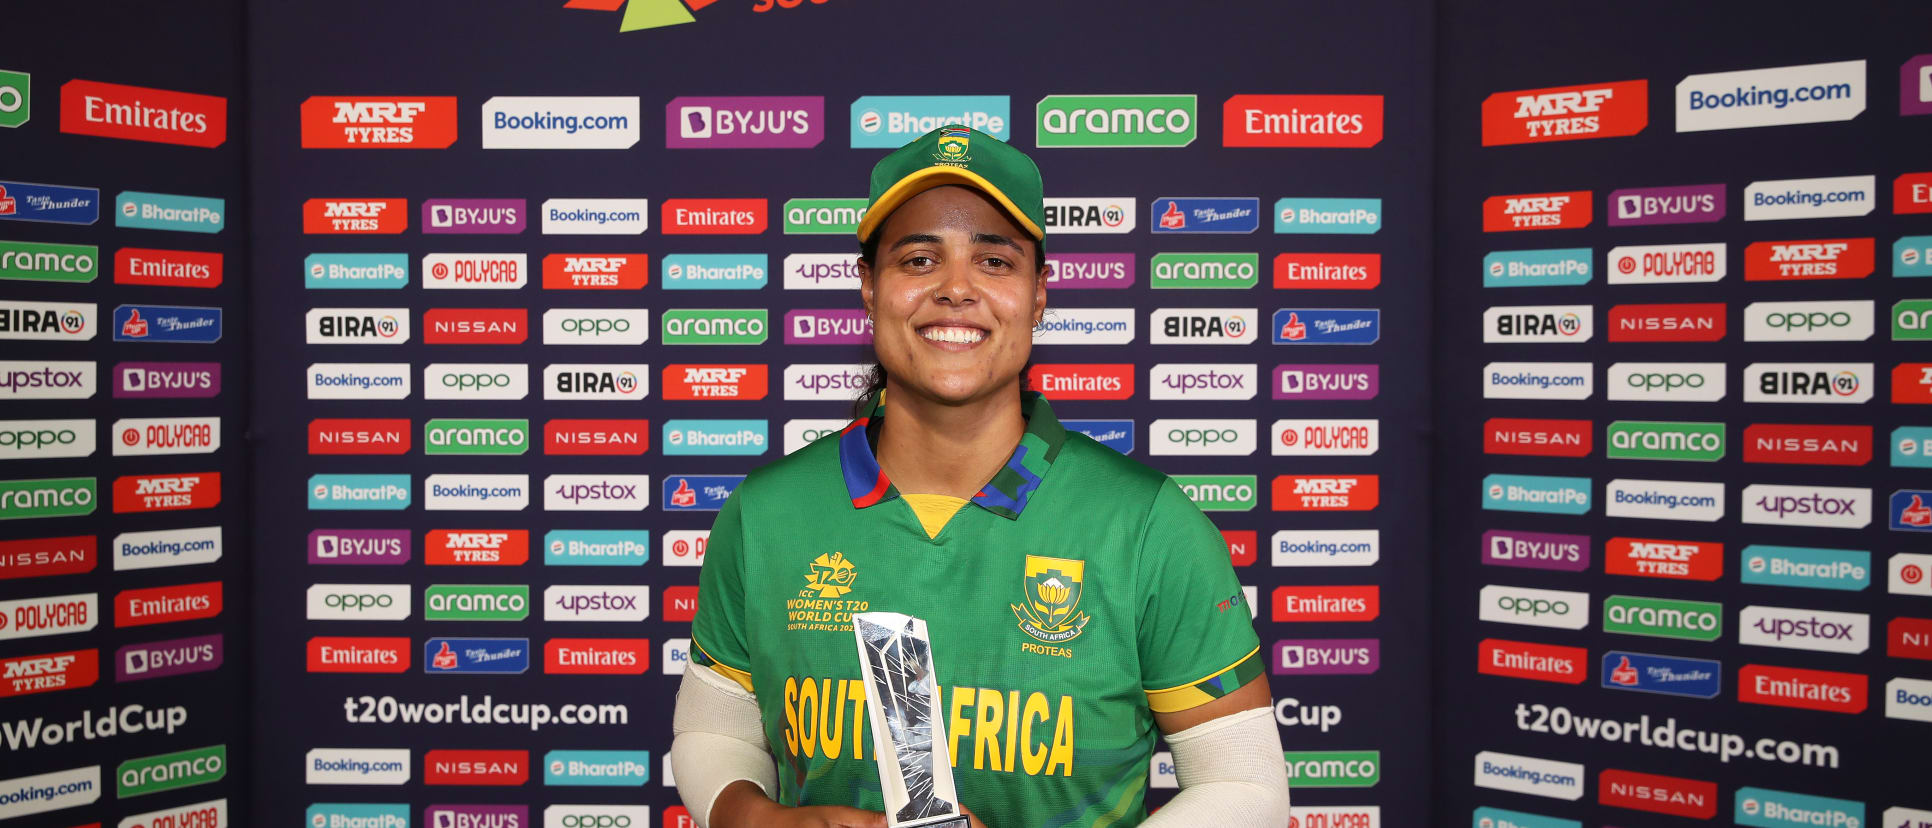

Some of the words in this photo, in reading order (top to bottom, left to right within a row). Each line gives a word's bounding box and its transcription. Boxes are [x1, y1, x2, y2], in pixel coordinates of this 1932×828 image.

[1513, 89, 1612, 118] MRF
[1690, 84, 1850, 110] Booking.com
[84, 96, 206, 133] Emirates
[332, 102, 425, 123] MRF
[1043, 108, 1190, 134] aramco
[494, 112, 627, 134] Booking.com
[716, 110, 809, 134] BYJU'S
[1244, 109, 1362, 134] Emirates
[1526, 116, 1599, 137] TYRES
[344, 127, 413, 143] TYRES
[41, 198, 91, 211] Thunder
[1503, 196, 1570, 214] MRF
[1643, 195, 1714, 215] BYJU'S
[1754, 191, 1864, 206] Booking.com
[141, 204, 220, 224] BharatPe
[323, 202, 386, 217] MRF
[454, 208, 516, 224] BYJU'S
[550, 209, 639, 224] Booking.com
[676, 208, 754, 225] Emirates
[1107, 211, 1119, 221] 91
[1298, 209, 1377, 224] BharatPe
[331, 219, 378, 230] TYRES
[1512, 214, 1560, 227] TYRES
[1769, 243, 1847, 261] MRF
[2, 251, 93, 273] ramco
[129, 258, 209, 278] Emirates
[563, 258, 626, 272] MRF
[1062, 262, 1125, 279] BYJU'S
[1155, 262, 1253, 279] aramco
[1507, 260, 1588, 277] BharatPe
[1643, 251, 1714, 276] POLYCAB
[1779, 263, 1837, 276] TYRES
[328, 264, 404, 279] BharatPe
[454, 261, 517, 282] POLYCAB
[571, 275, 618, 285] TYRES
[686, 265, 763, 280] BharatPe
[1287, 263, 1367, 280] Emirates
[65, 316, 79, 328] 91
[382, 321, 394, 332] 91
[435, 322, 516, 332] NISSAN
[560, 319, 630, 336] oppo
[666, 318, 763, 335] aramco
[1229, 321, 1241, 332] 91
[1563, 318, 1575, 330] 91
[1620, 318, 1712, 329] NISSAN
[1765, 312, 1851, 331] oppo
[148, 372, 210, 388] BYJU'S
[315, 374, 402, 389] Booking.com
[441, 374, 510, 391] oppo
[620, 377, 632, 388] 91
[683, 368, 746, 383] MRF
[1042, 373, 1121, 391] Emirates
[1161, 370, 1243, 394] upstox
[1305, 374, 1368, 390] BYJU'S
[1491, 373, 1584, 388] Booking.com
[1627, 373, 1704, 392] oppo
[1838, 378, 1853, 390] 91
[691, 385, 738, 396] TYRES
[0, 430, 75, 450] oppo
[146, 425, 210, 448] POLYCAB
[319, 432, 399, 443] NISSAN
[429, 429, 524, 445] aramco
[555, 432, 637, 443] NISSAN
[686, 430, 764, 445] BharatPe
[1167, 430, 1238, 446] oppo
[1304, 427, 1368, 448] POLYCAB
[1495, 432, 1580, 445] NISSAN
[1611, 431, 1720, 451] aramco
[1756, 438, 1857, 452] NISSAN
[135, 477, 200, 494] MRF
[331, 485, 407, 500] BharatPe
[432, 485, 520, 500] Booking.com
[555, 481, 635, 504] upstox
[1292, 479, 1357, 494] MRF
[1, 488, 92, 509] ramco
[143, 495, 191, 507] TYRES
[1300, 496, 1348, 507] TYRES
[1506, 486, 1587, 504] BharatPe
[1615, 490, 1715, 508] Booking.com
[1755, 494, 1855, 518] upstox
[121, 541, 214, 556] Booking.com
[340, 538, 401, 555] BYJU'S
[445, 533, 508, 548] MRF
[567, 541, 645, 556] BharatPe
[1279, 541, 1370, 556] Booking.com
[453, 550, 499, 561] TYRES
[1515, 541, 1579, 561] BYJU'S
[1627, 542, 1699, 561] MRF
[1636, 560, 1688, 575] TYRES
[1770, 558, 1865, 580] BharatPe
[324, 594, 392, 611] oppo
[429, 594, 524, 611] aramco
[798, 590, 815, 598] ICC
[129, 596, 209, 616] Emirates
[555, 592, 636, 615] upstox
[787, 599, 843, 611] WOMEN'S
[846, 600, 869, 611] T20
[1286, 595, 1366, 613] Emirates
[1497, 596, 1569, 616] oppo
[15, 601, 87, 631] POLYCAB
[788, 611, 832, 622] WORLD
[834, 612, 854, 622] CU
[1608, 606, 1716, 630] aramco
[787, 623, 807, 631] SOUTH
[809, 623, 838, 631] AFRICA
[1024, 624, 1048, 640] SOUTH
[1049, 629, 1076, 640] AFRICA
[1753, 617, 1852, 640] upstox
[150, 645, 214, 669] BYJU'S
[320, 646, 397, 663] Emirates
[558, 648, 636, 665] Emirates
[1021, 643, 1073, 658] PROTEAS
[1305, 648, 1369, 665] BYJU'S
[3, 655, 75, 678] MRF
[1492, 649, 1573, 673] Emirates
[13, 674, 66, 692] TYRES
[1755, 676, 1850, 702] Emirates
[344, 696, 628, 731] t20worldcup.com
[0, 704, 187, 750] WorldCup
[784, 676, 877, 760] SOUT
[944, 685, 1074, 777] FRICA
[1515, 703, 1838, 768] t20worldcup.com
[122, 756, 221, 786] aramco
[314, 759, 402, 774] Booking.com
[435, 762, 517, 774] NISSAN
[567, 761, 645, 776] BharatPe
[1483, 762, 1575, 786] Booking.com
[0, 780, 92, 805] ooking.com
[1611, 783, 1703, 806] NISSAN
[330, 814, 406, 828] BharatPe
[458, 813, 519, 828] BYJU'S
[563, 815, 631, 828] oppo
[1763, 802, 1860, 828] BharatPe
